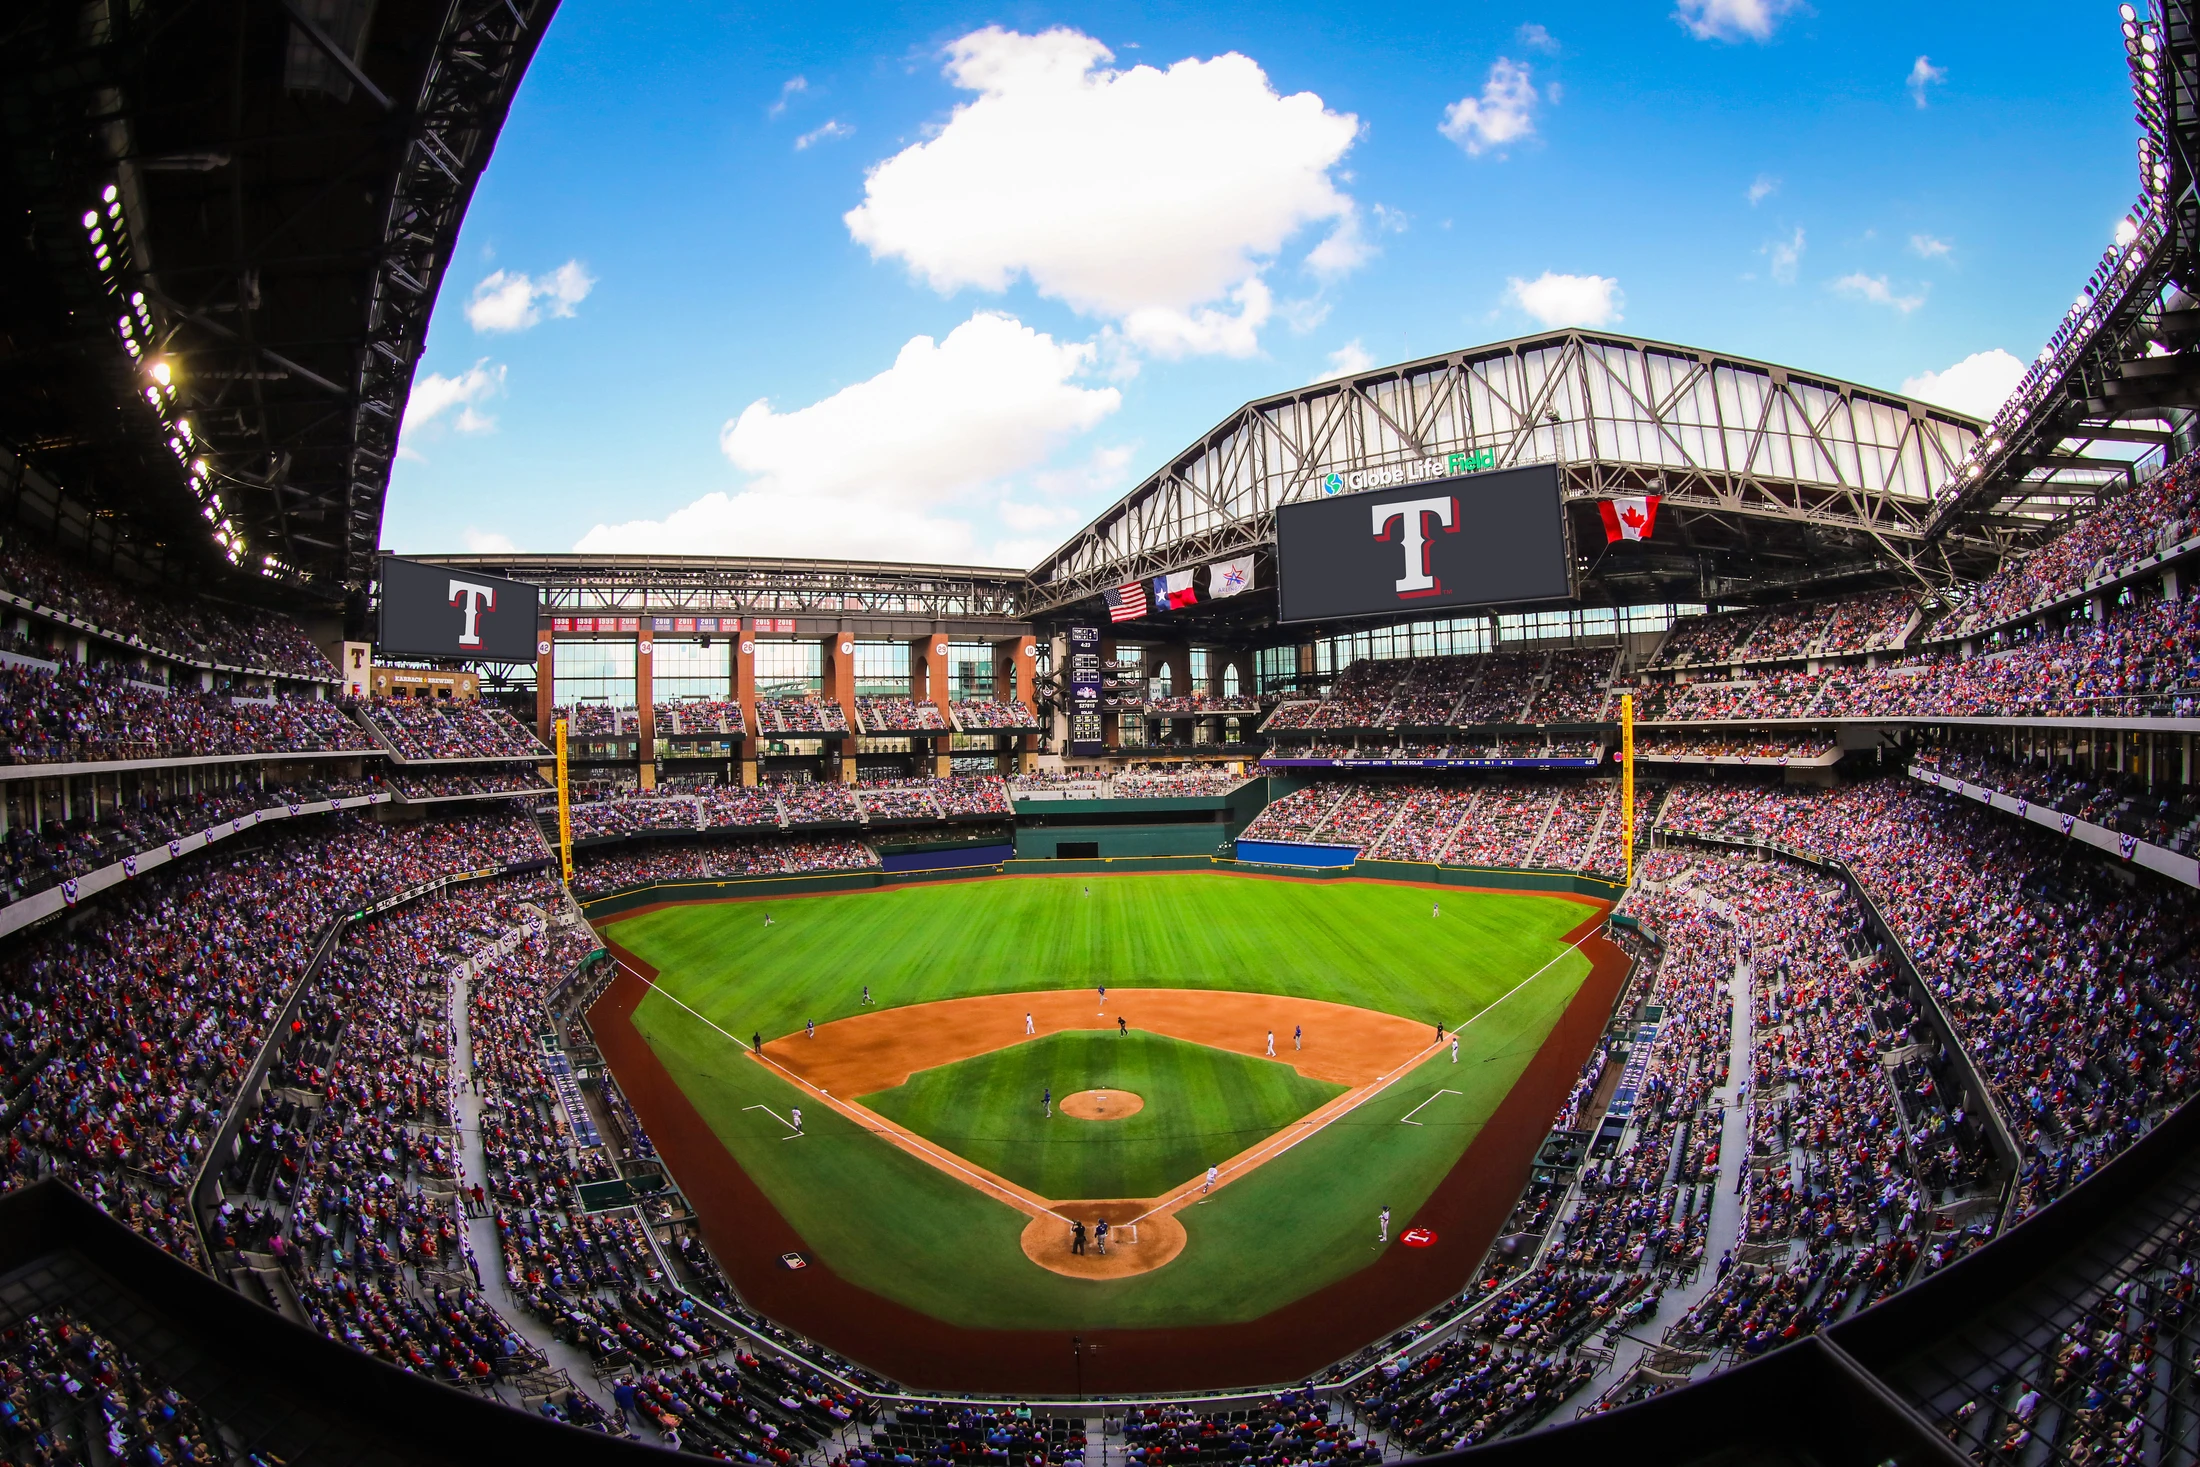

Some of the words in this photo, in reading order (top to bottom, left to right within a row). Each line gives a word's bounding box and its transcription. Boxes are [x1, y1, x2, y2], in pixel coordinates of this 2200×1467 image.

[1348, 467, 1404, 490] Globe
[1408, 458, 1444, 480] Life
[1447, 447, 1495, 473] Field
[1371, 495, 1460, 599] T
[448, 579, 497, 650] T
[539, 643, 549, 652] 42
[641, 643, 651, 651] 34
[743, 643, 753, 651] 26
[845, 644, 850, 652] 7
[394, 675, 423, 683] KARBACH
